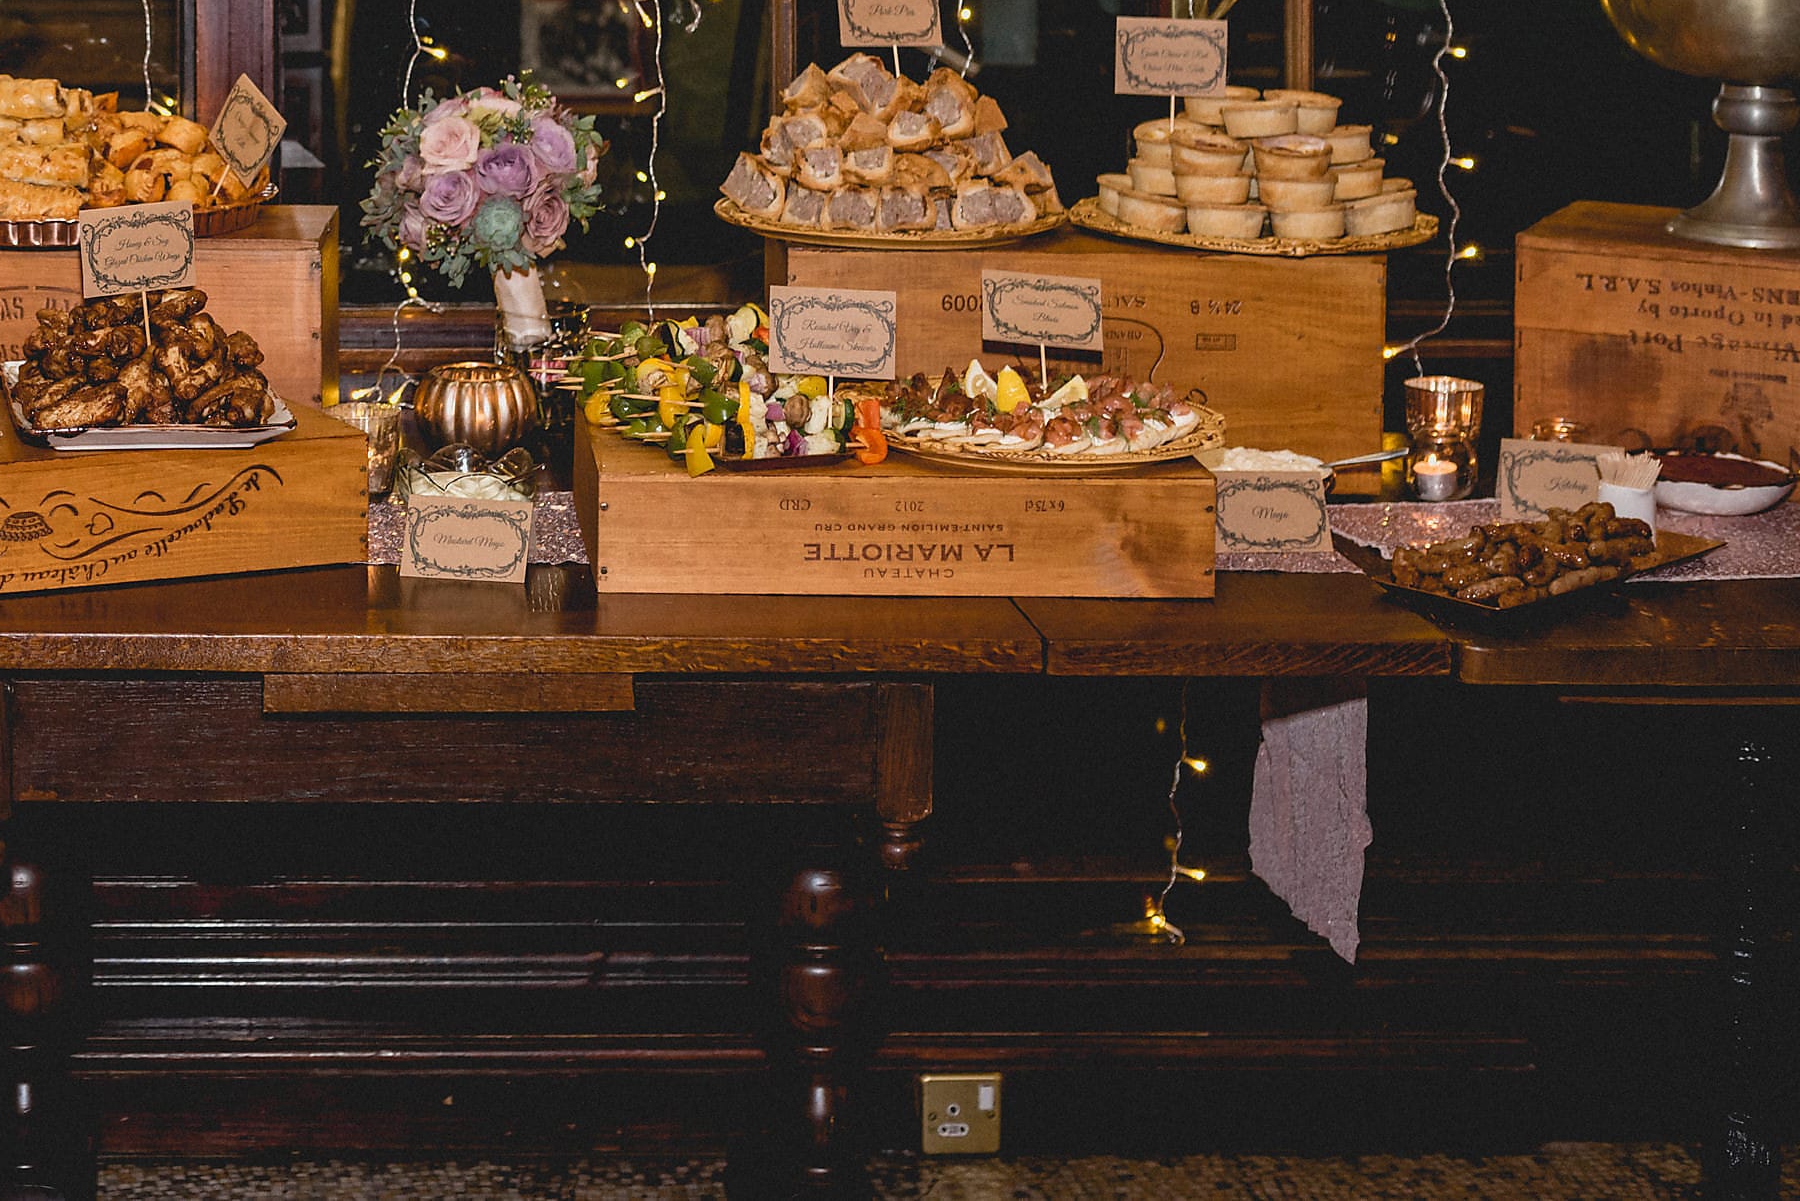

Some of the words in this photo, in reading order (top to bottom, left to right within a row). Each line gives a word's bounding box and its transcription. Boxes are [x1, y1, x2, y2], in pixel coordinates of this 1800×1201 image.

[1103, 296, 1146, 308] SAU
[1638, 299, 1660, 319] by
[1669, 305, 1745, 327] Oporto
[1754, 311, 1772, 327] in
[801, 319, 837, 332] Roasted
[862, 324, 872, 334] &
[1629, 328, 1683, 354] Port
[243, 471, 261, 493] de
[1544, 477, 1589, 495] Ketchup
[779, 499, 812, 511] CRD
[895, 500, 925, 512] 2012
[1251, 505, 1289, 523] Mayo
[144, 496, 247, 553] Ladoucette
[814, 523, 842, 532] CRU
[847, 523, 896, 533] GRAND
[433, 533, 472, 545] Mustard
[472, 535, 505, 550] Mayo
[114, 548, 138, 565] au
[804, 543, 963, 562] MARIOTTE
[974, 543, 1015, 562] LA
[23, 558, 109, 584] Château
[863, 567, 955, 579] CHATEAU
